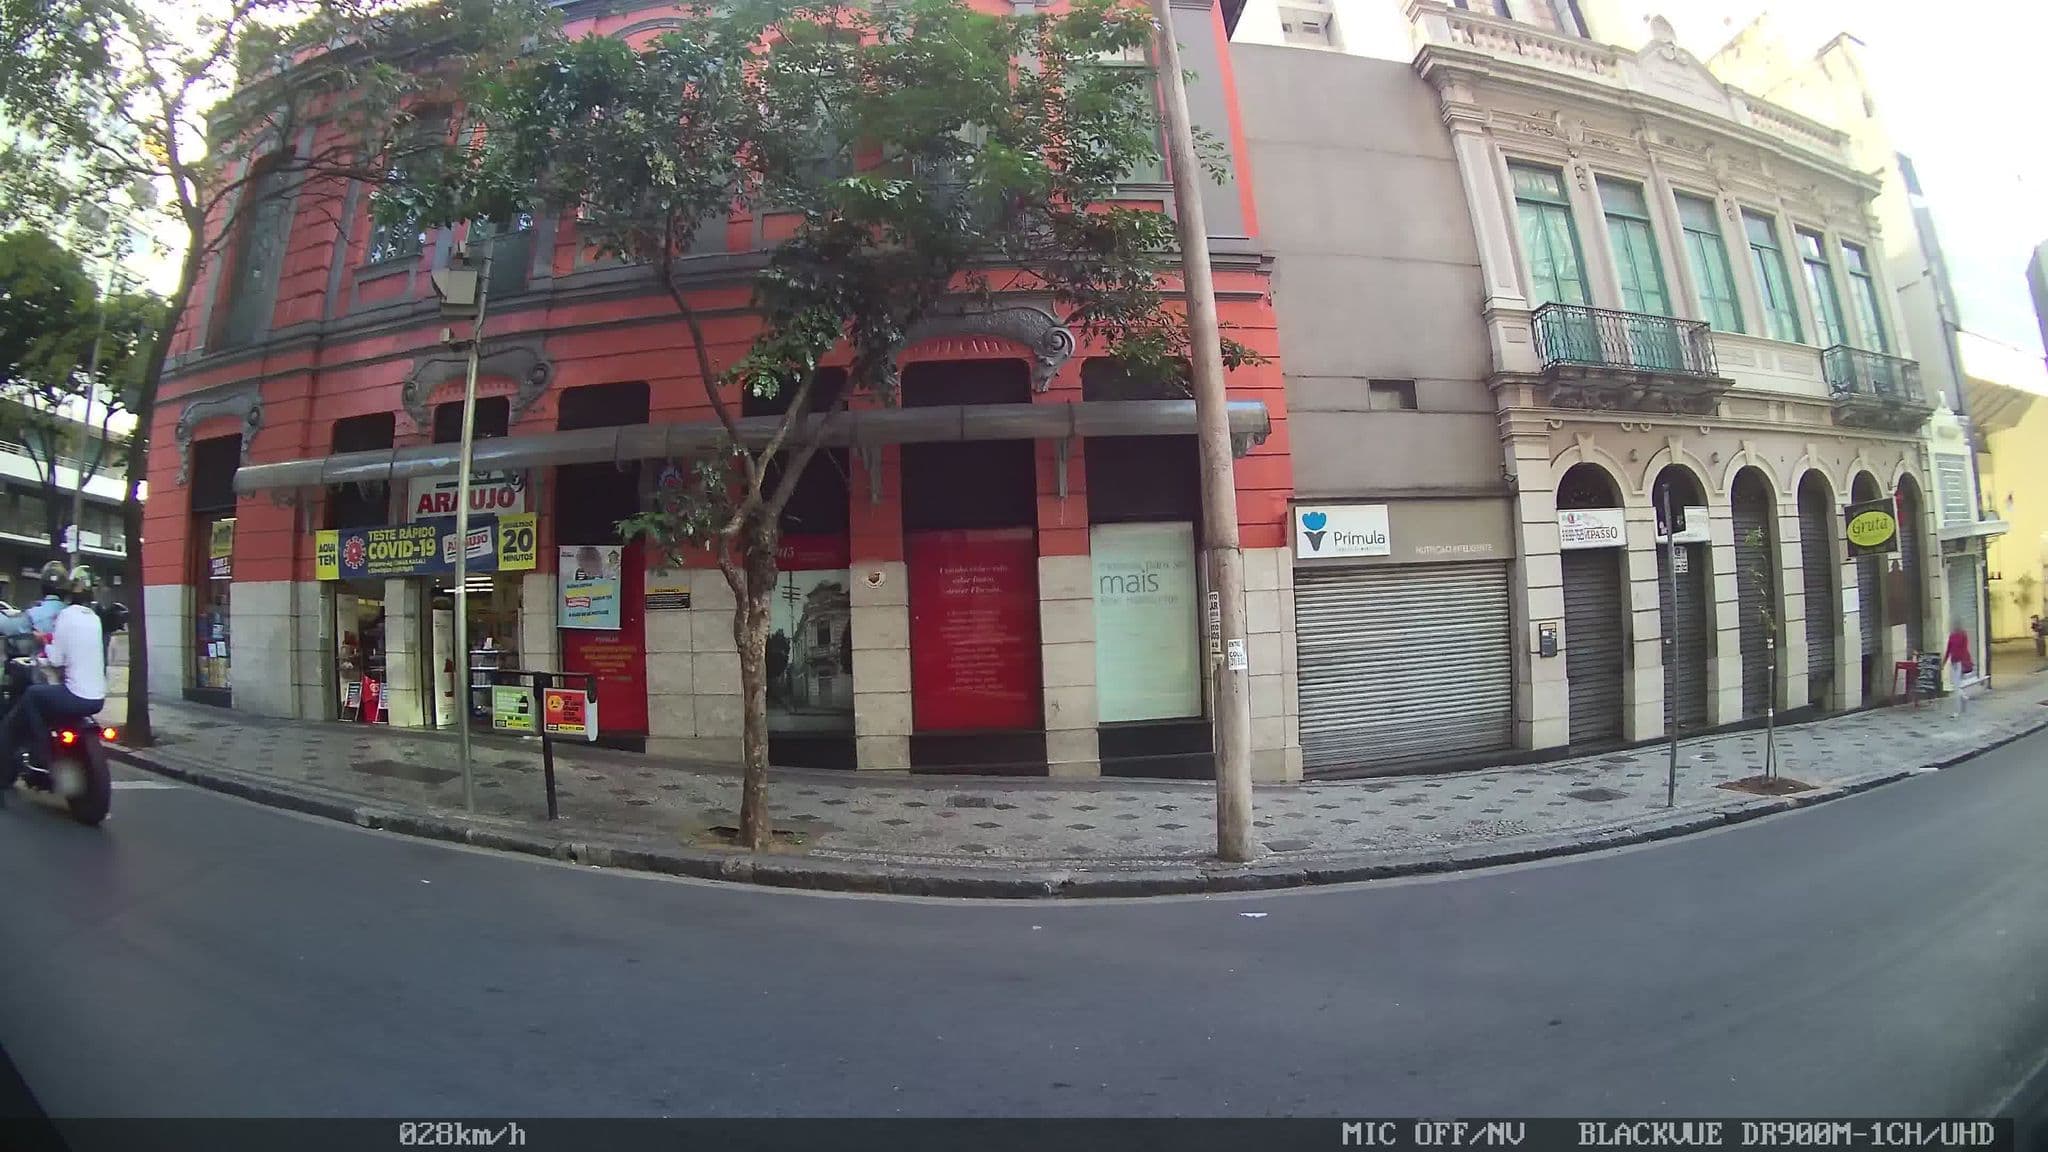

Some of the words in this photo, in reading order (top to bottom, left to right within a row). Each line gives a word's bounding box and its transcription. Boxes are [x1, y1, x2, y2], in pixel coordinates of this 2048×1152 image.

[368, 529, 396, 541] TESTE
[503, 528, 533, 553] 20
[368, 538, 436, 560] COVID-19
[503, 553, 534, 562] MINUTOS
[318, 554, 336, 566] TEM
[1100, 569, 1159, 595] mais
